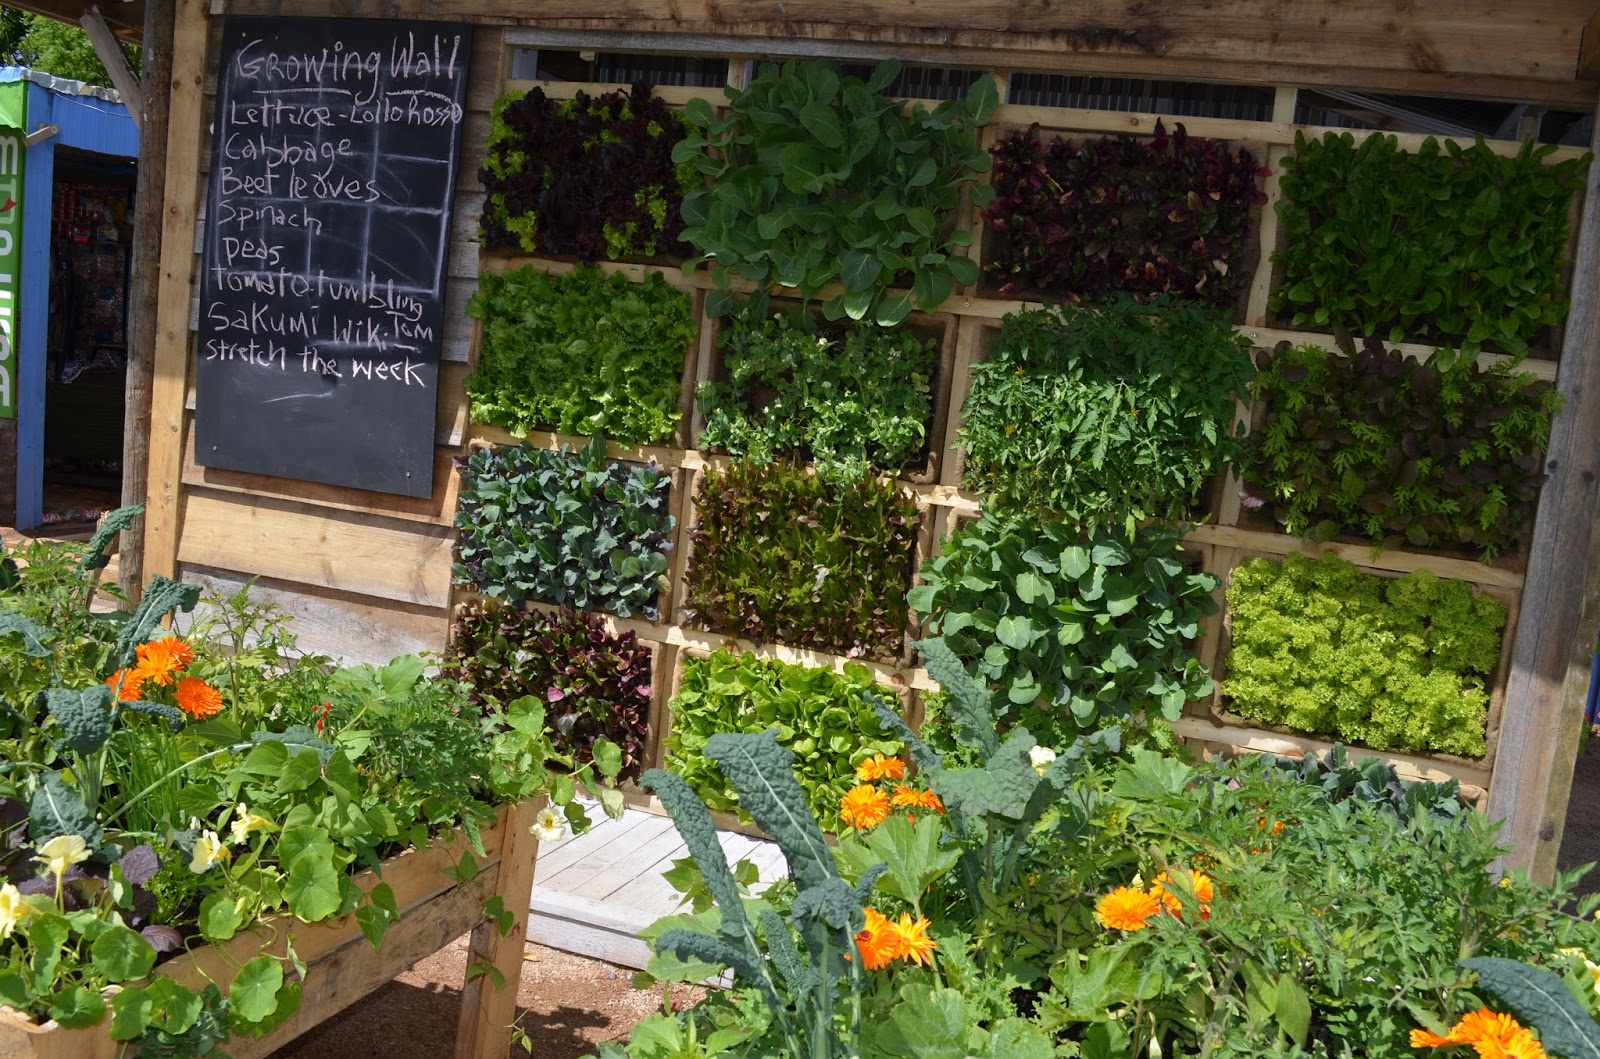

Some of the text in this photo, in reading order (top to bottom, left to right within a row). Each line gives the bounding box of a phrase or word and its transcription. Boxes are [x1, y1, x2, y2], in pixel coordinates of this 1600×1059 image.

[391, 31, 461, 79] Wall
[225, 132, 353, 178] Cabbage
[220, 166, 380, 203] Beet leaves
[218, 199, 322, 235] Spinach
[296, 345, 343, 378] the
[352, 356, 426, 388] week
